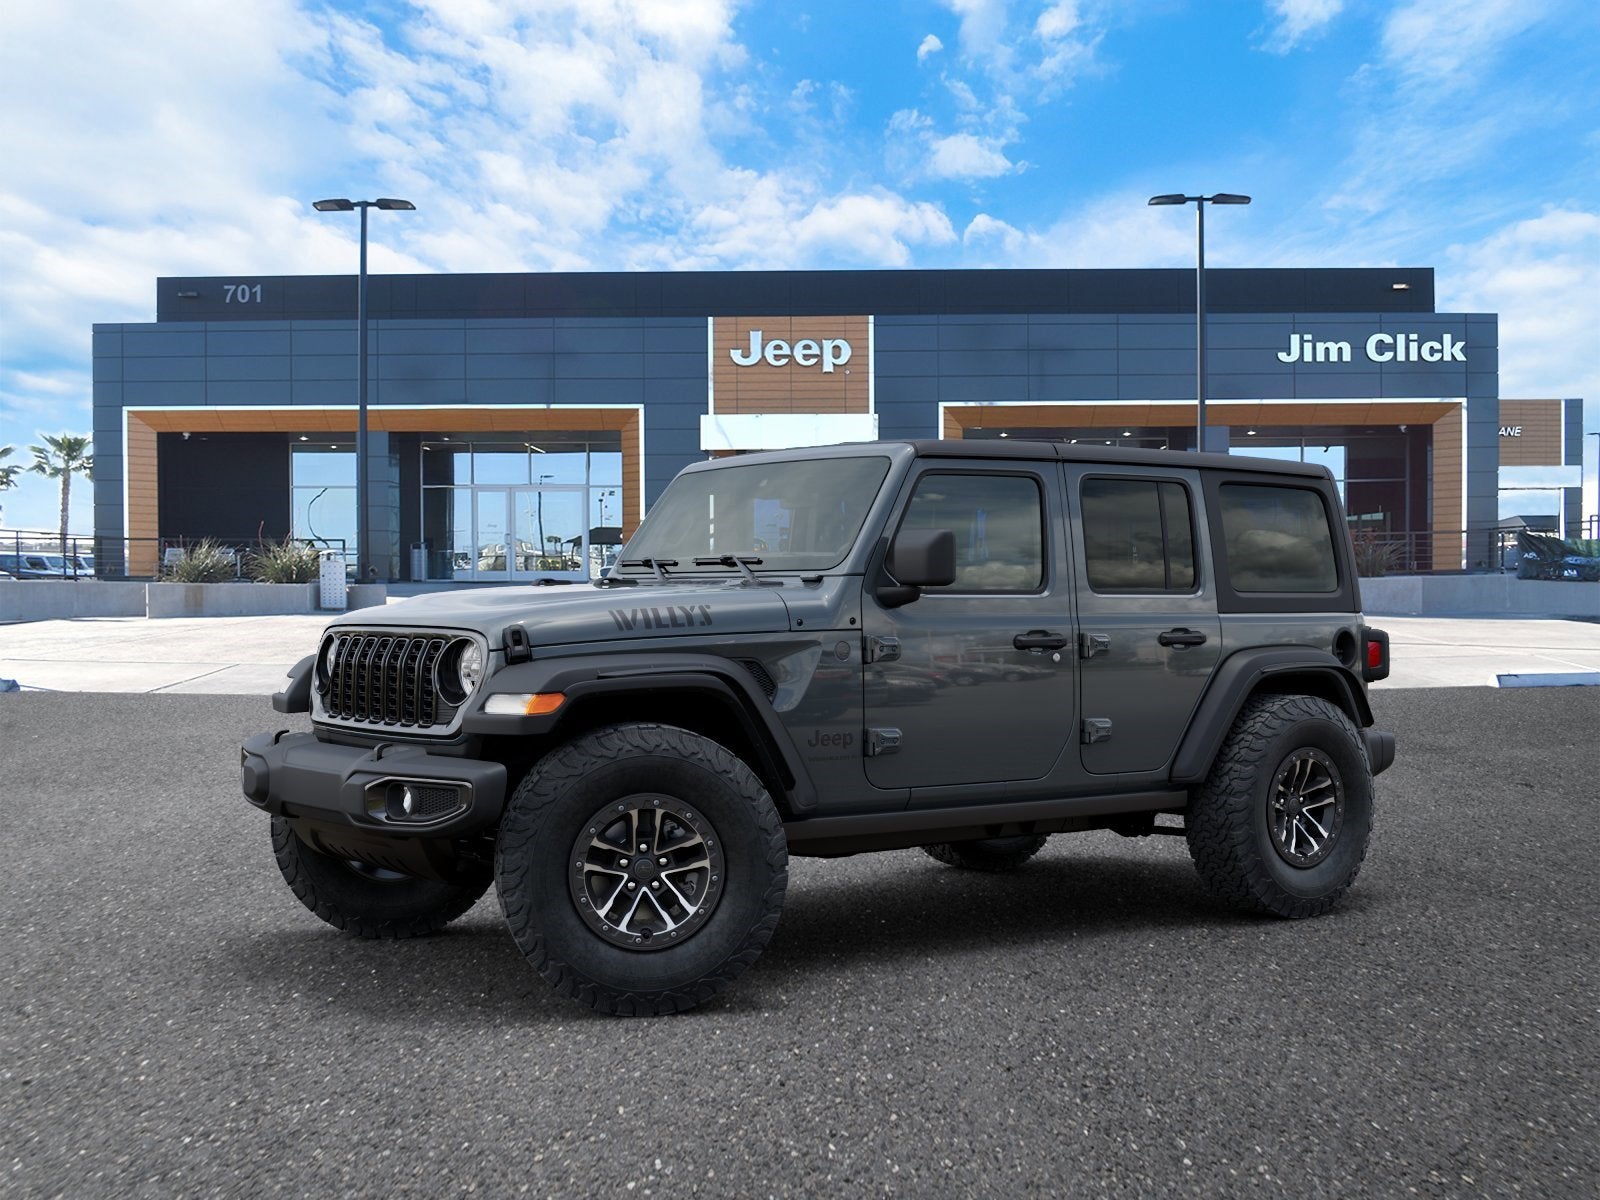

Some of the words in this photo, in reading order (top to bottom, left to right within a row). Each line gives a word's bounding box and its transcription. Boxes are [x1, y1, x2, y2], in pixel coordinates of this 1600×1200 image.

[224, 284, 261, 303] 701
[730, 330, 852, 373] Jeep
[1277, 334, 1351, 362] Jim
[1366, 333, 1467, 362] Click
[608, 604, 713, 631] WILLYS
[807, 729, 853, 749] Jeep
